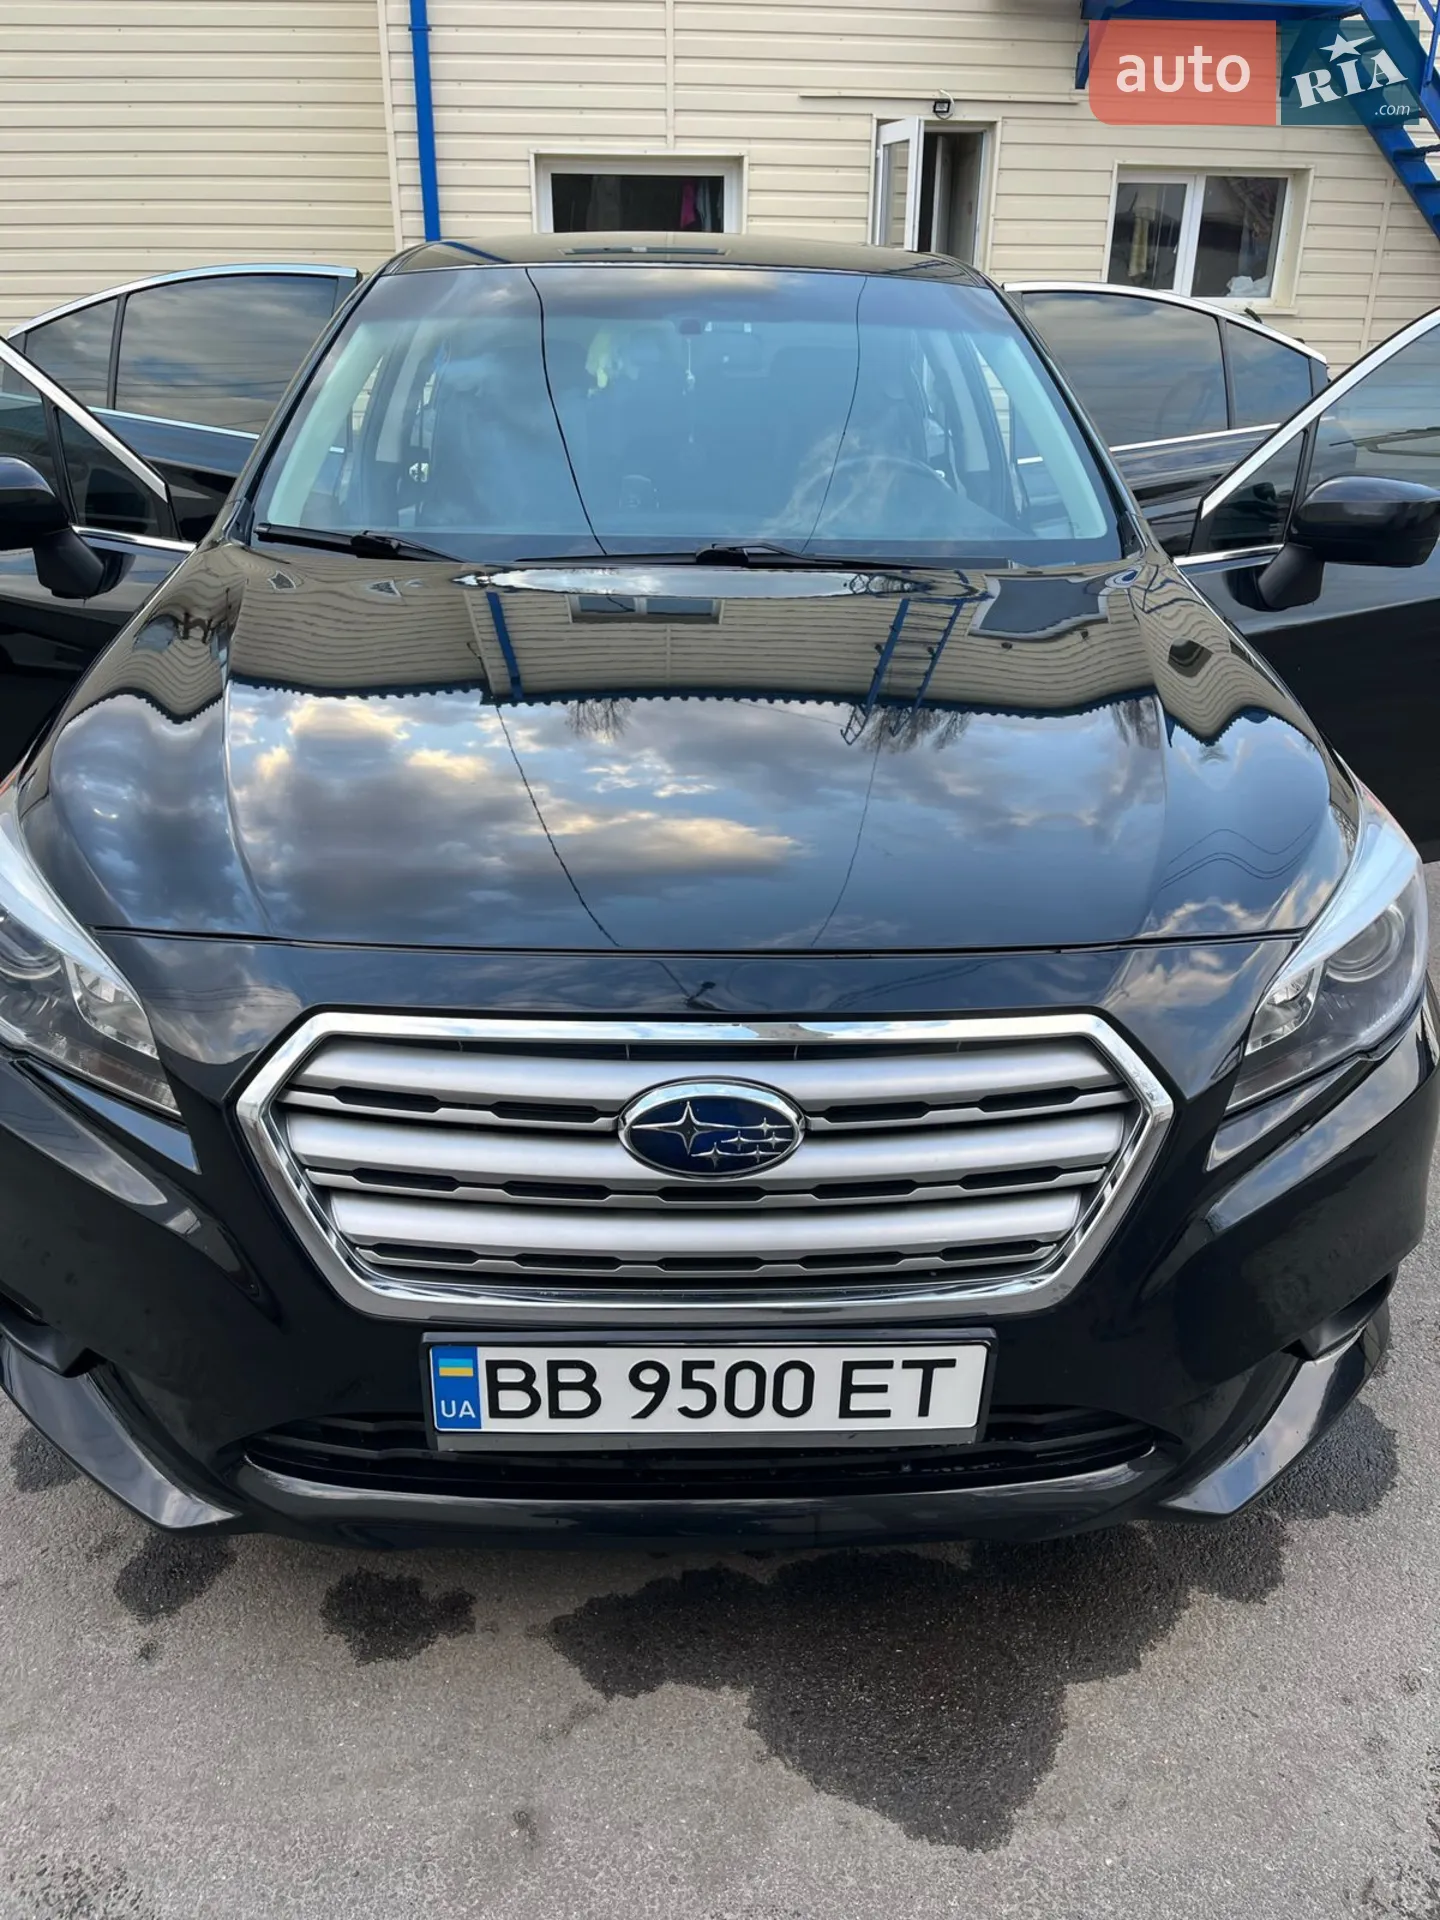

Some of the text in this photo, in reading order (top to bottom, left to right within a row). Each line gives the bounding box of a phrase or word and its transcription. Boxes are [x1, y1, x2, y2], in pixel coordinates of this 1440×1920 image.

[485, 1357, 957, 1419] BB 9500 ET
[440, 1400, 476, 1419] UA
